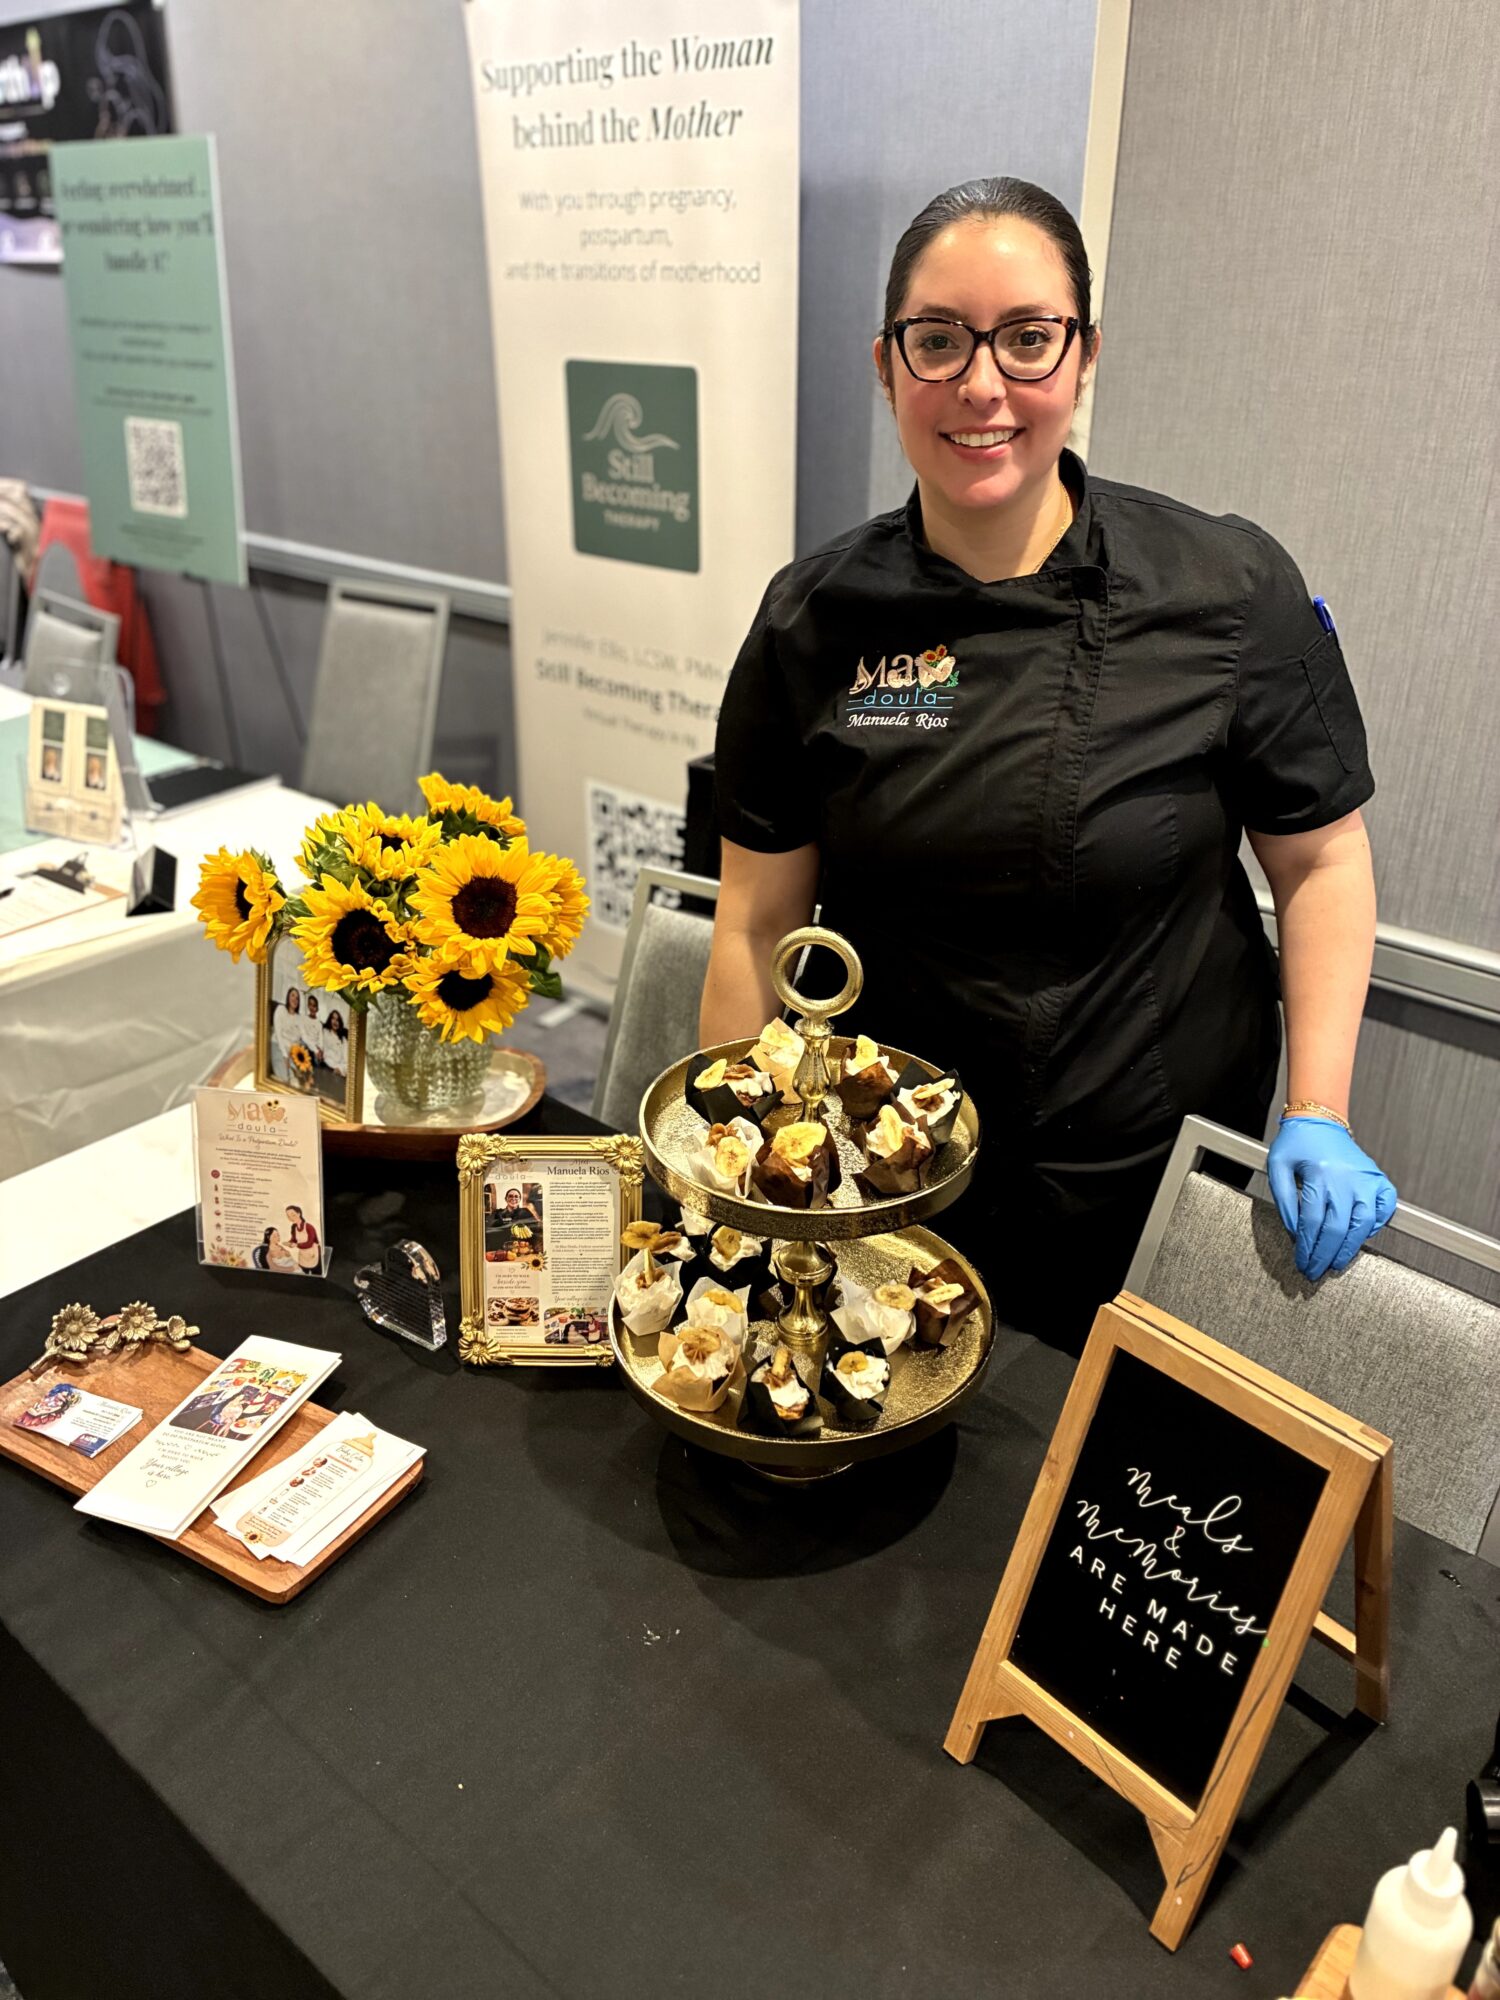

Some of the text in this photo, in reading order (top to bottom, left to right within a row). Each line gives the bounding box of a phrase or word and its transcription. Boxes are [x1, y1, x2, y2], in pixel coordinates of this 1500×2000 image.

[481, 35, 774, 97] Supporting the Woman
[512, 101, 743, 150] behind the Mother
[556, 194, 583, 216] you
[649, 187, 737, 214] pregnancy,
[534, 261, 557, 281] the
[640, 260, 657, 281] of
[660, 262, 760, 284] motherhood
[607, 450, 655, 481] Still
[581, 473, 690, 522] Becoming
[604, 510, 660, 531] THERAPY
[863, 687, 937, 705] doula
[846, 711, 949, 730] Manuela Rios
[237, 1123, 276, 1133] doula
[547, 1166, 610, 1176] Manuela Rios
[1164, 1525, 1186, 1558] &
[1070, 1545, 1238, 1675] ARE MADE
[1099, 1598, 1181, 1669] HERE
